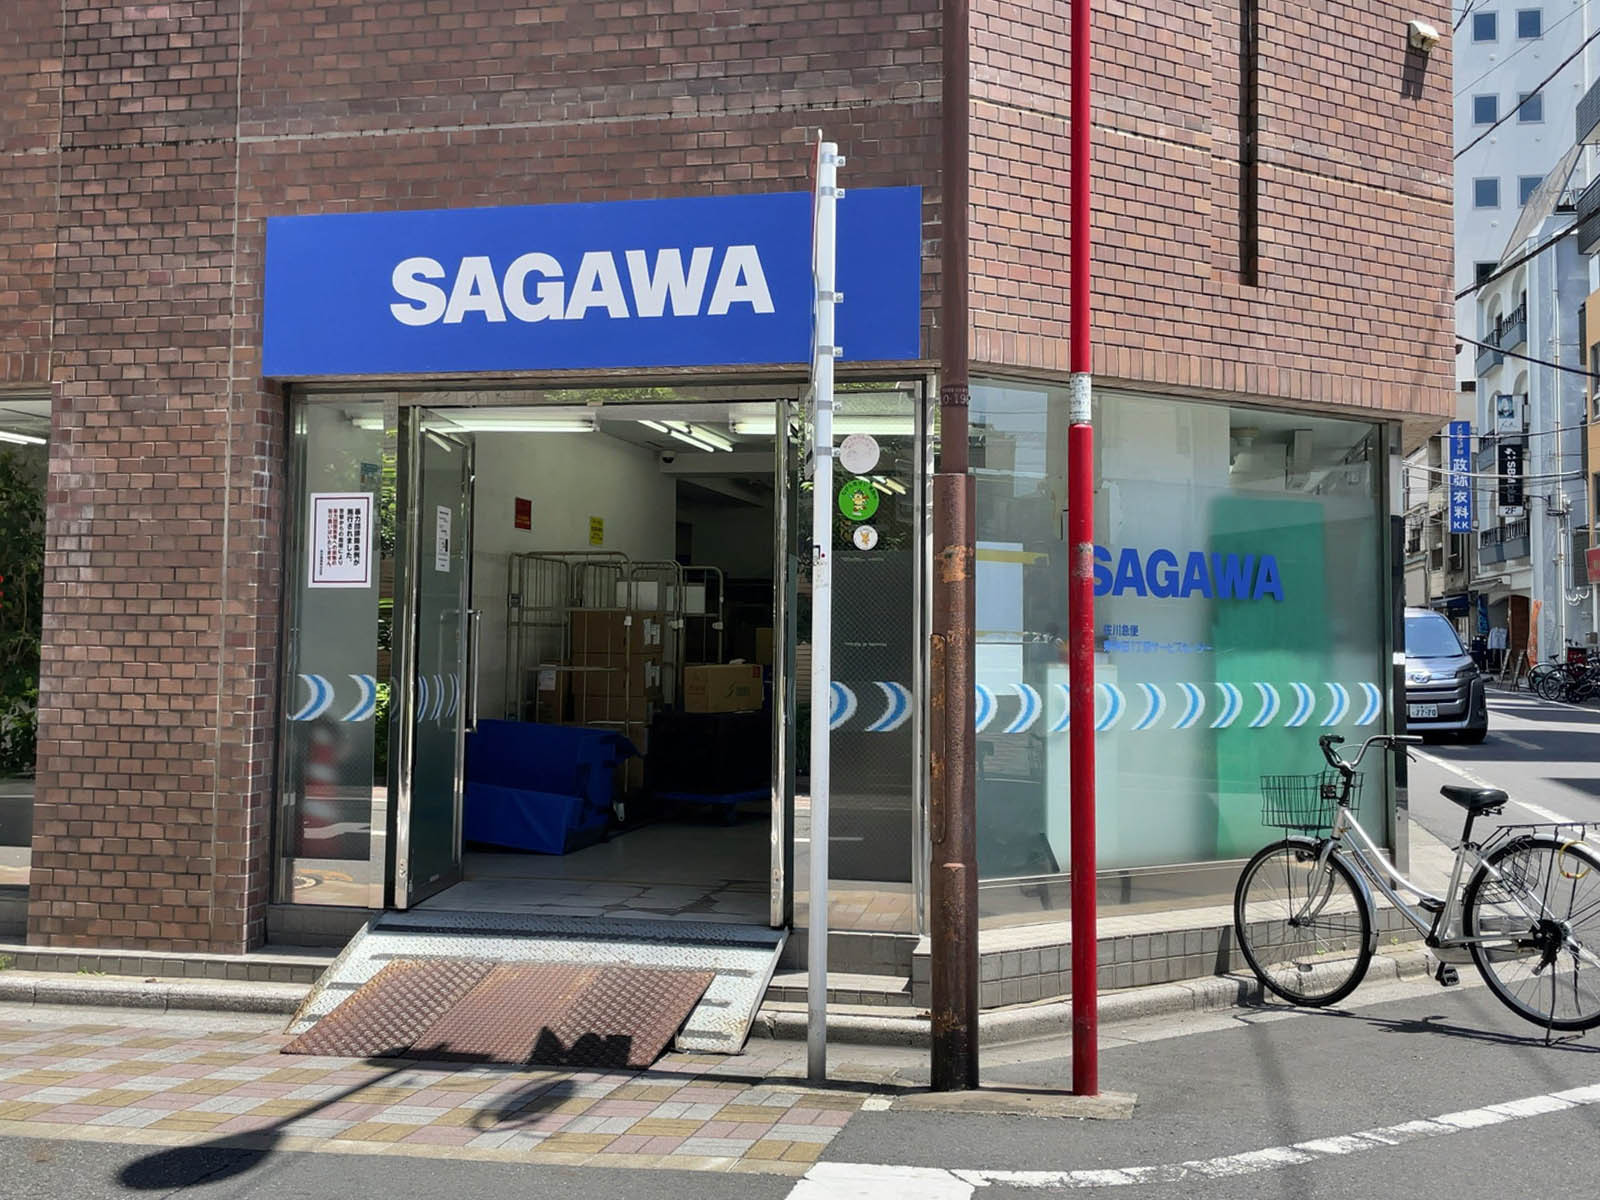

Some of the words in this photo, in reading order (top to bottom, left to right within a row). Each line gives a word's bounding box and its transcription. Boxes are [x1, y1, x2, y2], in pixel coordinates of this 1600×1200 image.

[390, 245, 775, 327] SAGAWA
[1505, 507, 1517, 515] 2F
[1093, 545, 1284, 602] SAGAWA
[1103, 625, 1139, 636] 佐川急便
